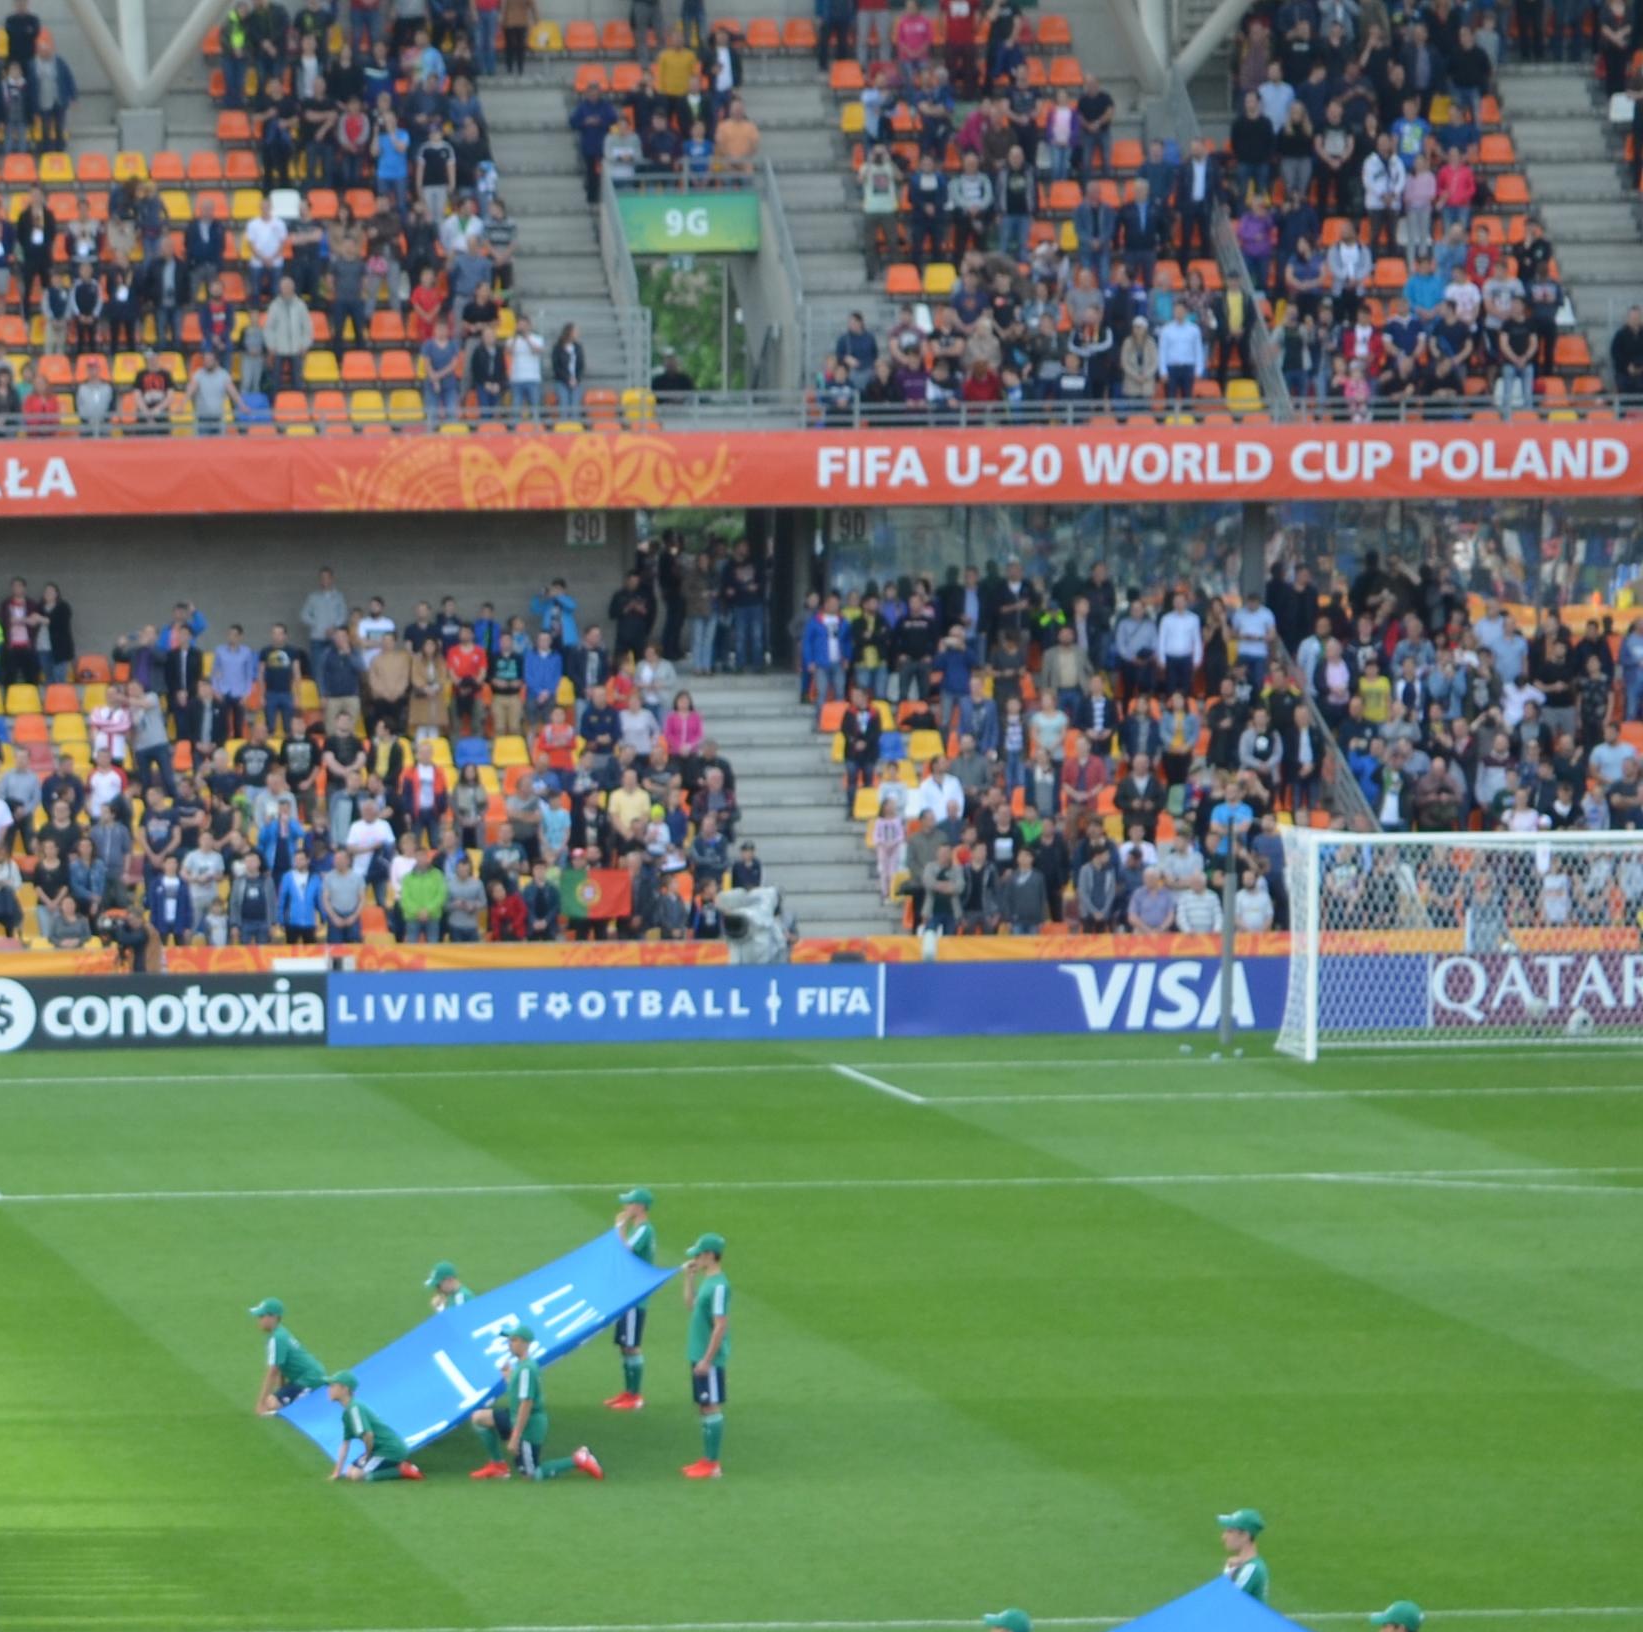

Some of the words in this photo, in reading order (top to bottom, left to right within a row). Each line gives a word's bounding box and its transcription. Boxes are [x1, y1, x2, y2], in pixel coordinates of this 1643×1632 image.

[665, 207, 709, 237] 9G
[816, 444, 928, 488] FIFA
[944, 443, 1062, 487] U-20
[1078, 441, 1273, 485] WORLD
[1290, 439, 1393, 484] CUP
[1409, 437, 1629, 482] POLAND
[42, 978, 325, 1037] conotoxia
[337, 993, 494, 1022] LIVING
[796, 986, 872, 1015] FIFA
[1058, 961, 1255, 1030] VISA
